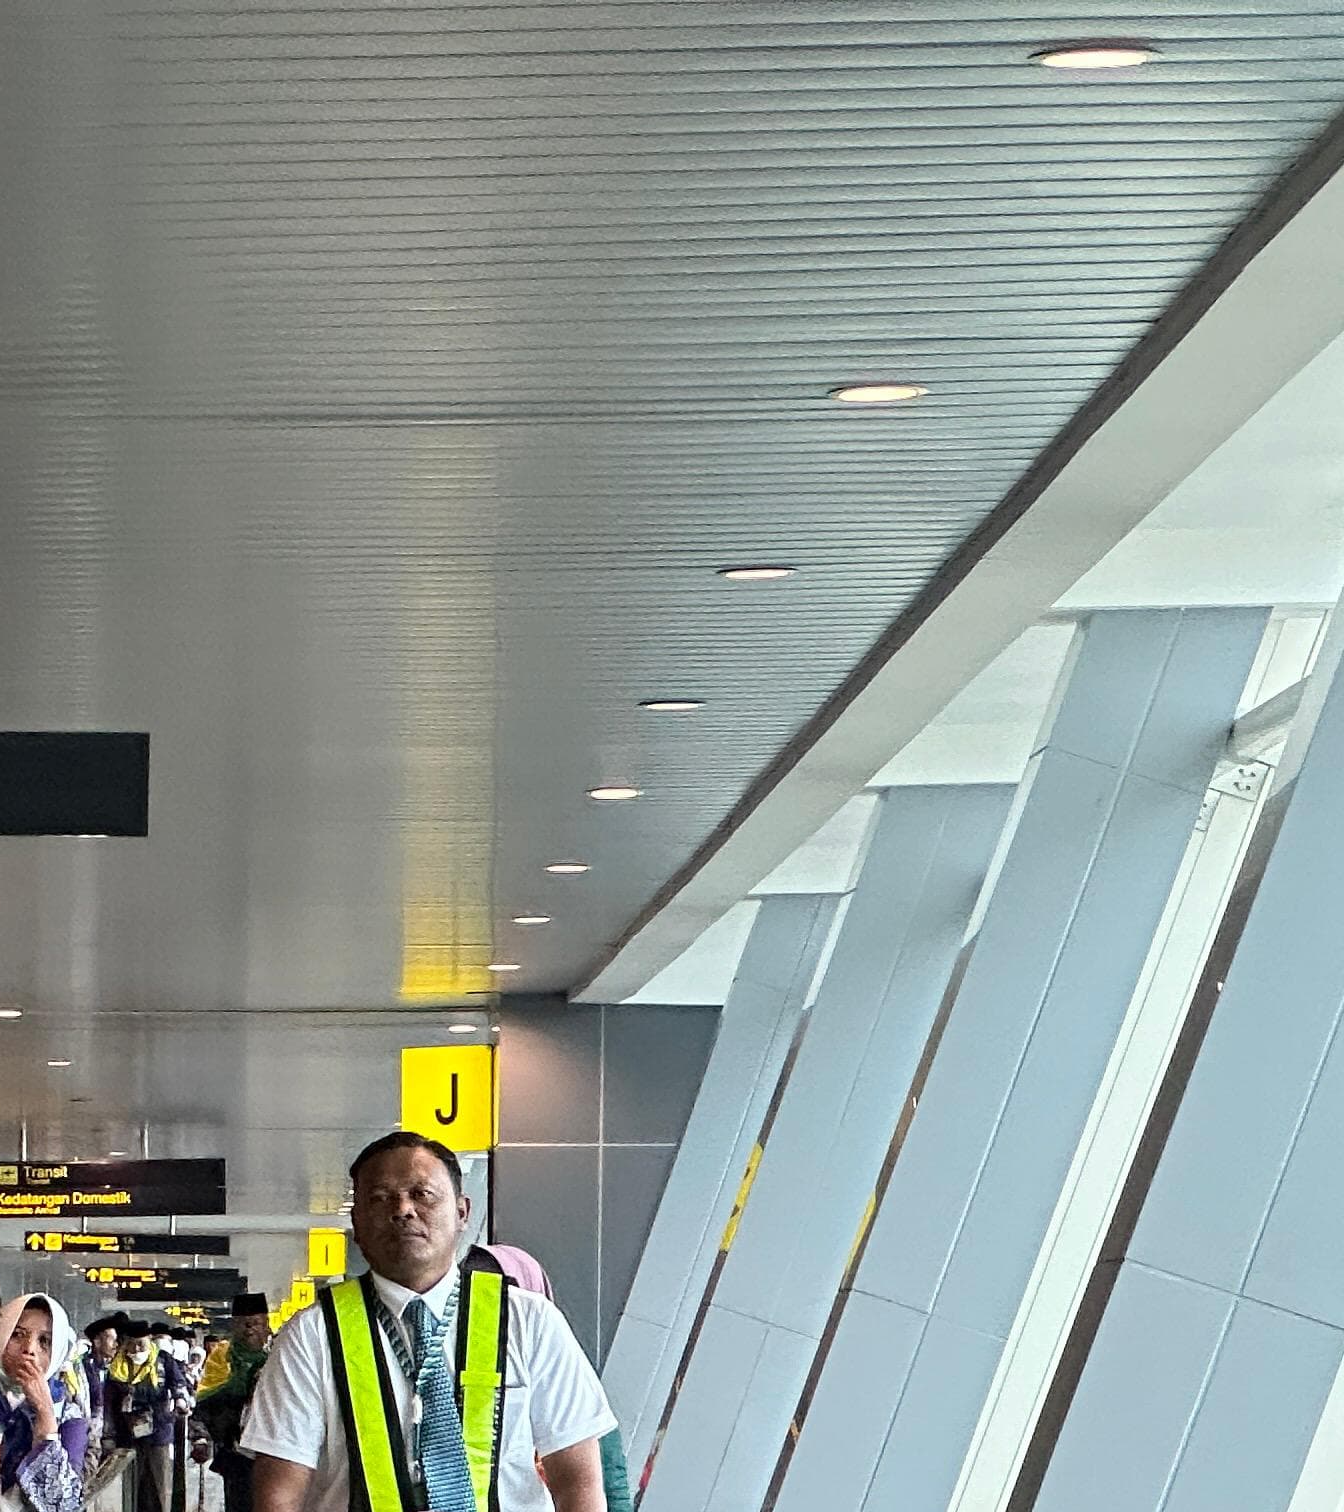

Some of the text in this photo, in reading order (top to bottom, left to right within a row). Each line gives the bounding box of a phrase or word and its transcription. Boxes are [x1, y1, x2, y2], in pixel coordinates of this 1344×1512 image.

[435, 1072, 458, 1126] J
[23, 1165, 68, 1178] Transit
[72, 1191, 131, 1205] Domestik
